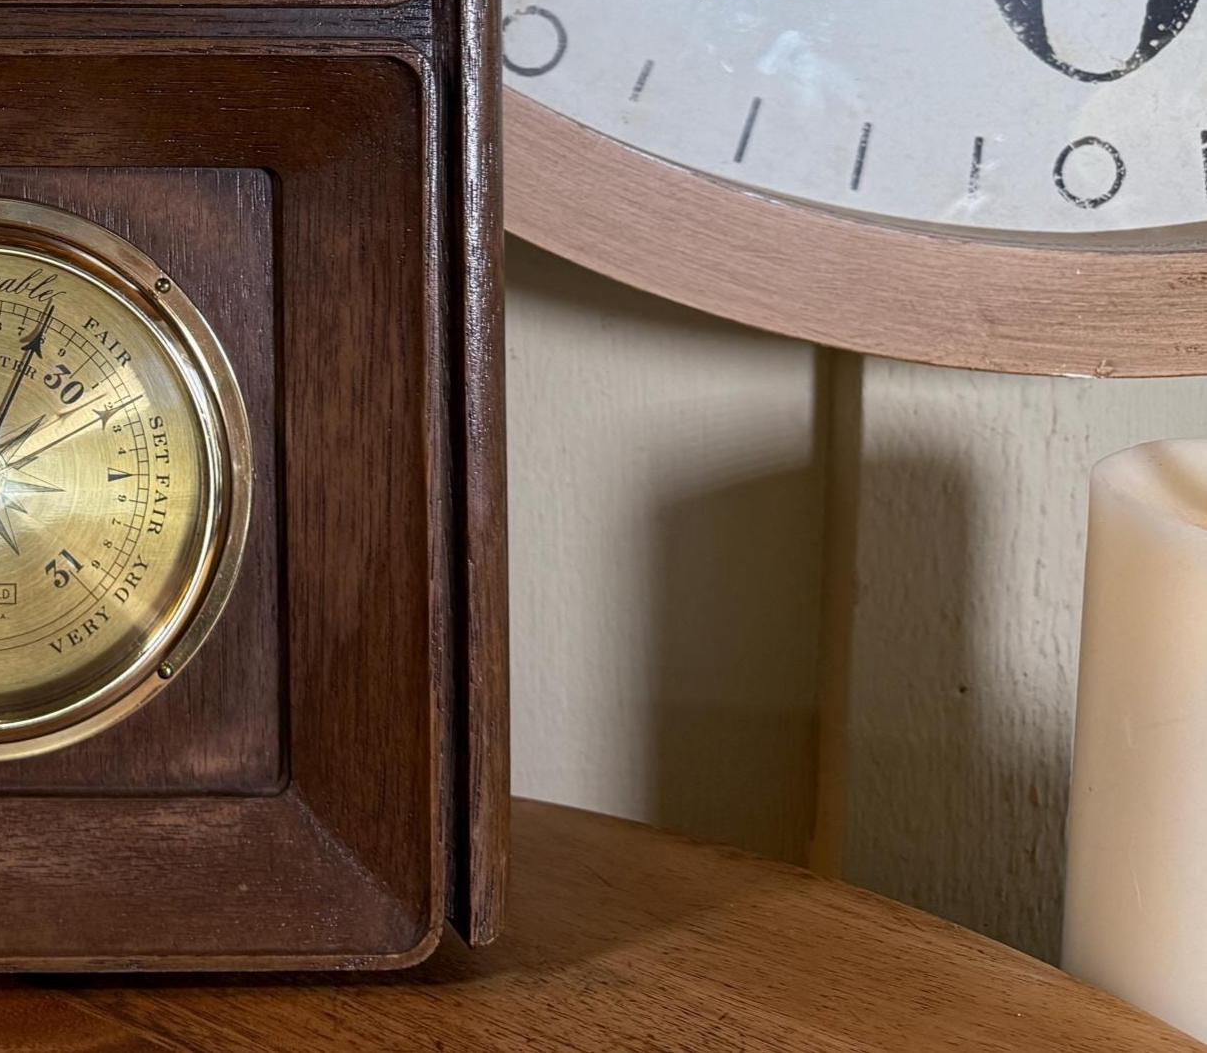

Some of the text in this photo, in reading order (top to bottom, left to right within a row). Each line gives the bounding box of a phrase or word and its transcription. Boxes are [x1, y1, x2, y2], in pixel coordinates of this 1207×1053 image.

[18, 327, 25, 336] 7
[82, 316, 133, 367] FAIR
[58, 348, 67, 357] 9
[44, 364, 84, 405] 30
[113, 424, 122, 433] 3
[118, 447, 127, 455] 4
[147, 415, 170, 535] SET FAIR
[111, 518, 121, 526] 7
[102, 539, 113, 548] 8
[45, 548, 85, 588] 31
[49, 554, 149, 655] VERY DRY
